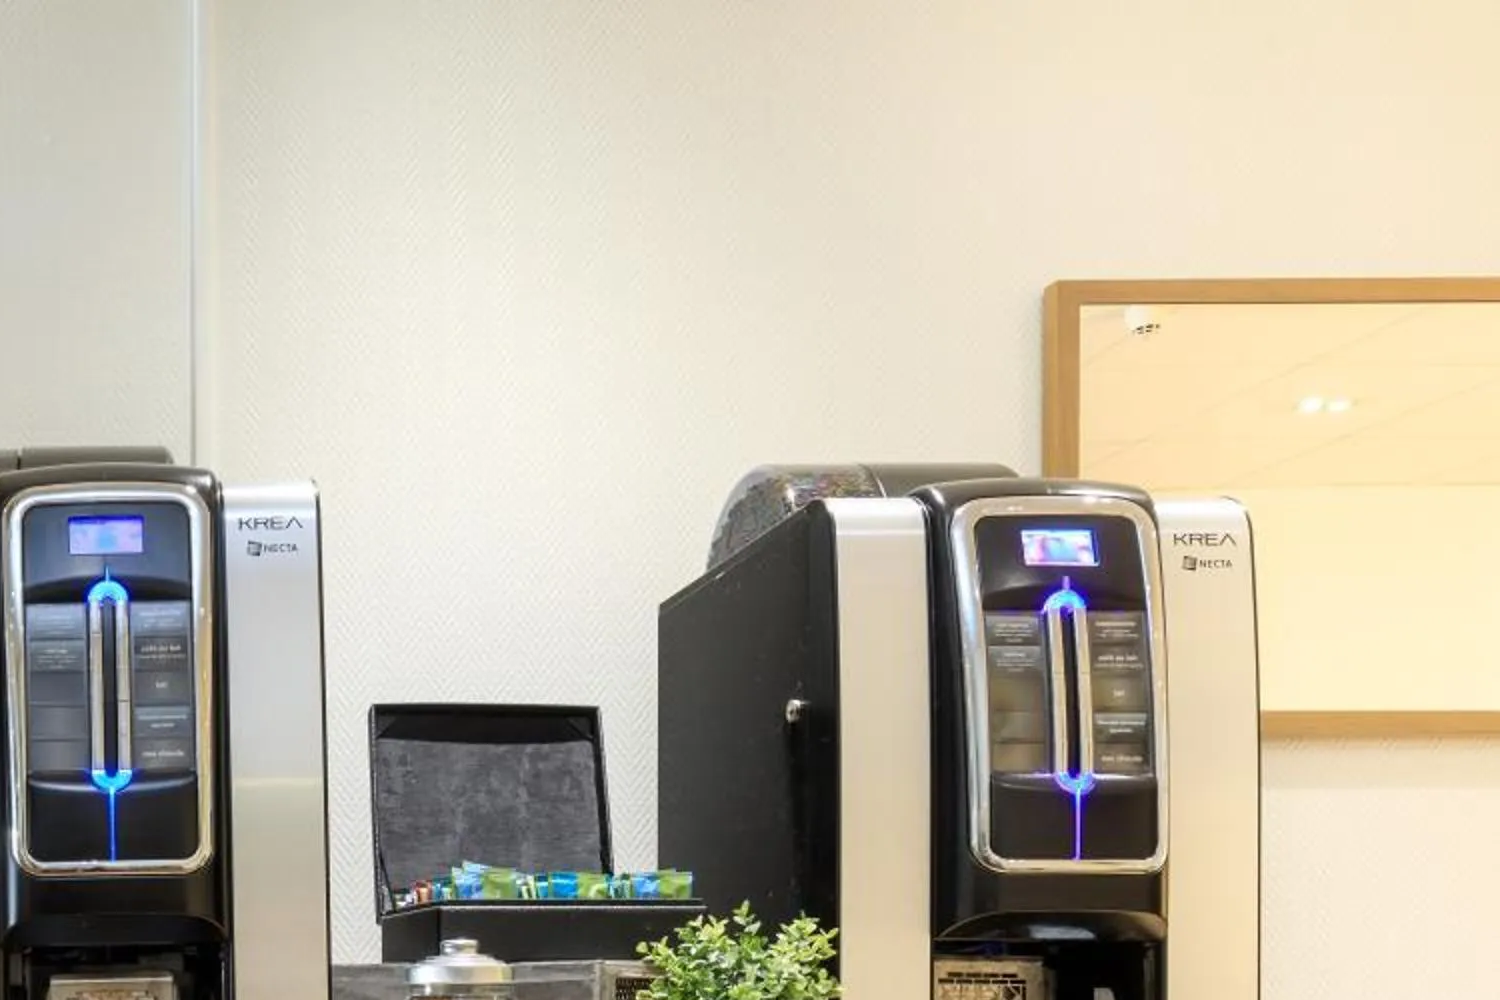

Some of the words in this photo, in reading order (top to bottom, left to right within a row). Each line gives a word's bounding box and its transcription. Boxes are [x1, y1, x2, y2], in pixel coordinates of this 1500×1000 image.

[238, 516, 303, 530] KREA
[1173, 532, 1236, 546] KREA
[263, 543, 298, 552] NECTA
[1199, 560, 1232, 568] NECTA
